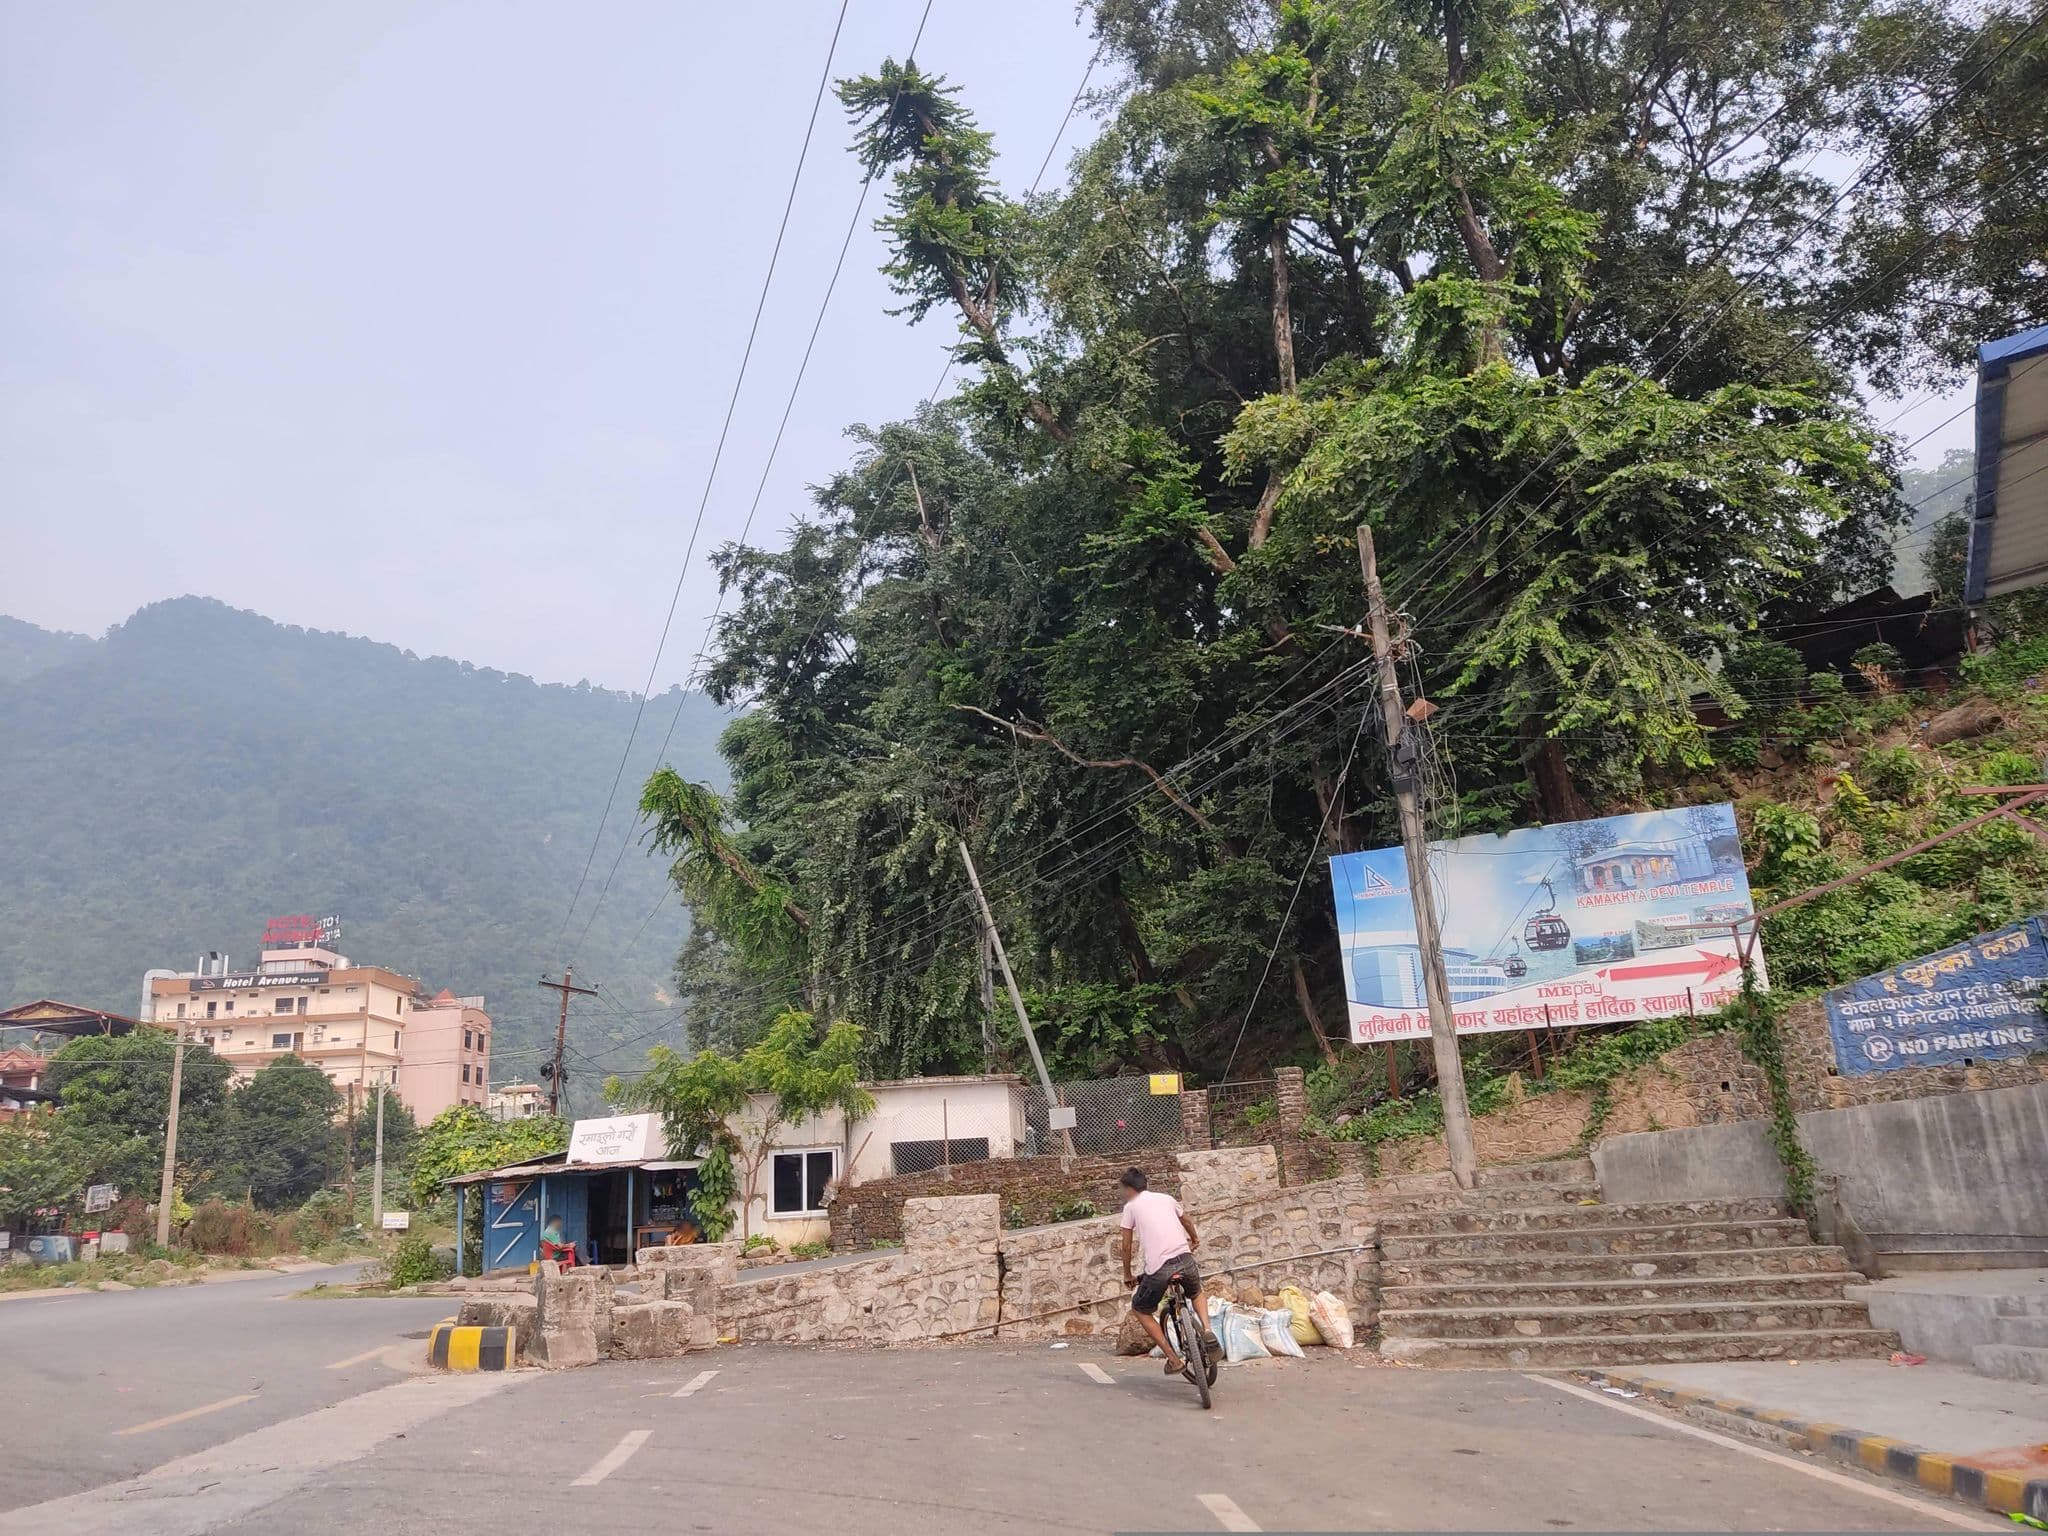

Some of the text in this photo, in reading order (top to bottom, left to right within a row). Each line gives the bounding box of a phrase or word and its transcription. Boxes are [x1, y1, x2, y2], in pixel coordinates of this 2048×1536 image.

[1577, 878, 1735, 908] KAMAKHYA DEVI TEMPLE
[223, 977, 253, 988] Hotel
[258, 976, 299, 986] Avenue
[1358, 1013, 1412, 1039] लुम्बिनी
[1585, 995, 1637, 1018] हार्दिक
[1642, 993, 1694, 1013] स्वागत
[1900, 1026, 2036, 1055] NO PARKING
